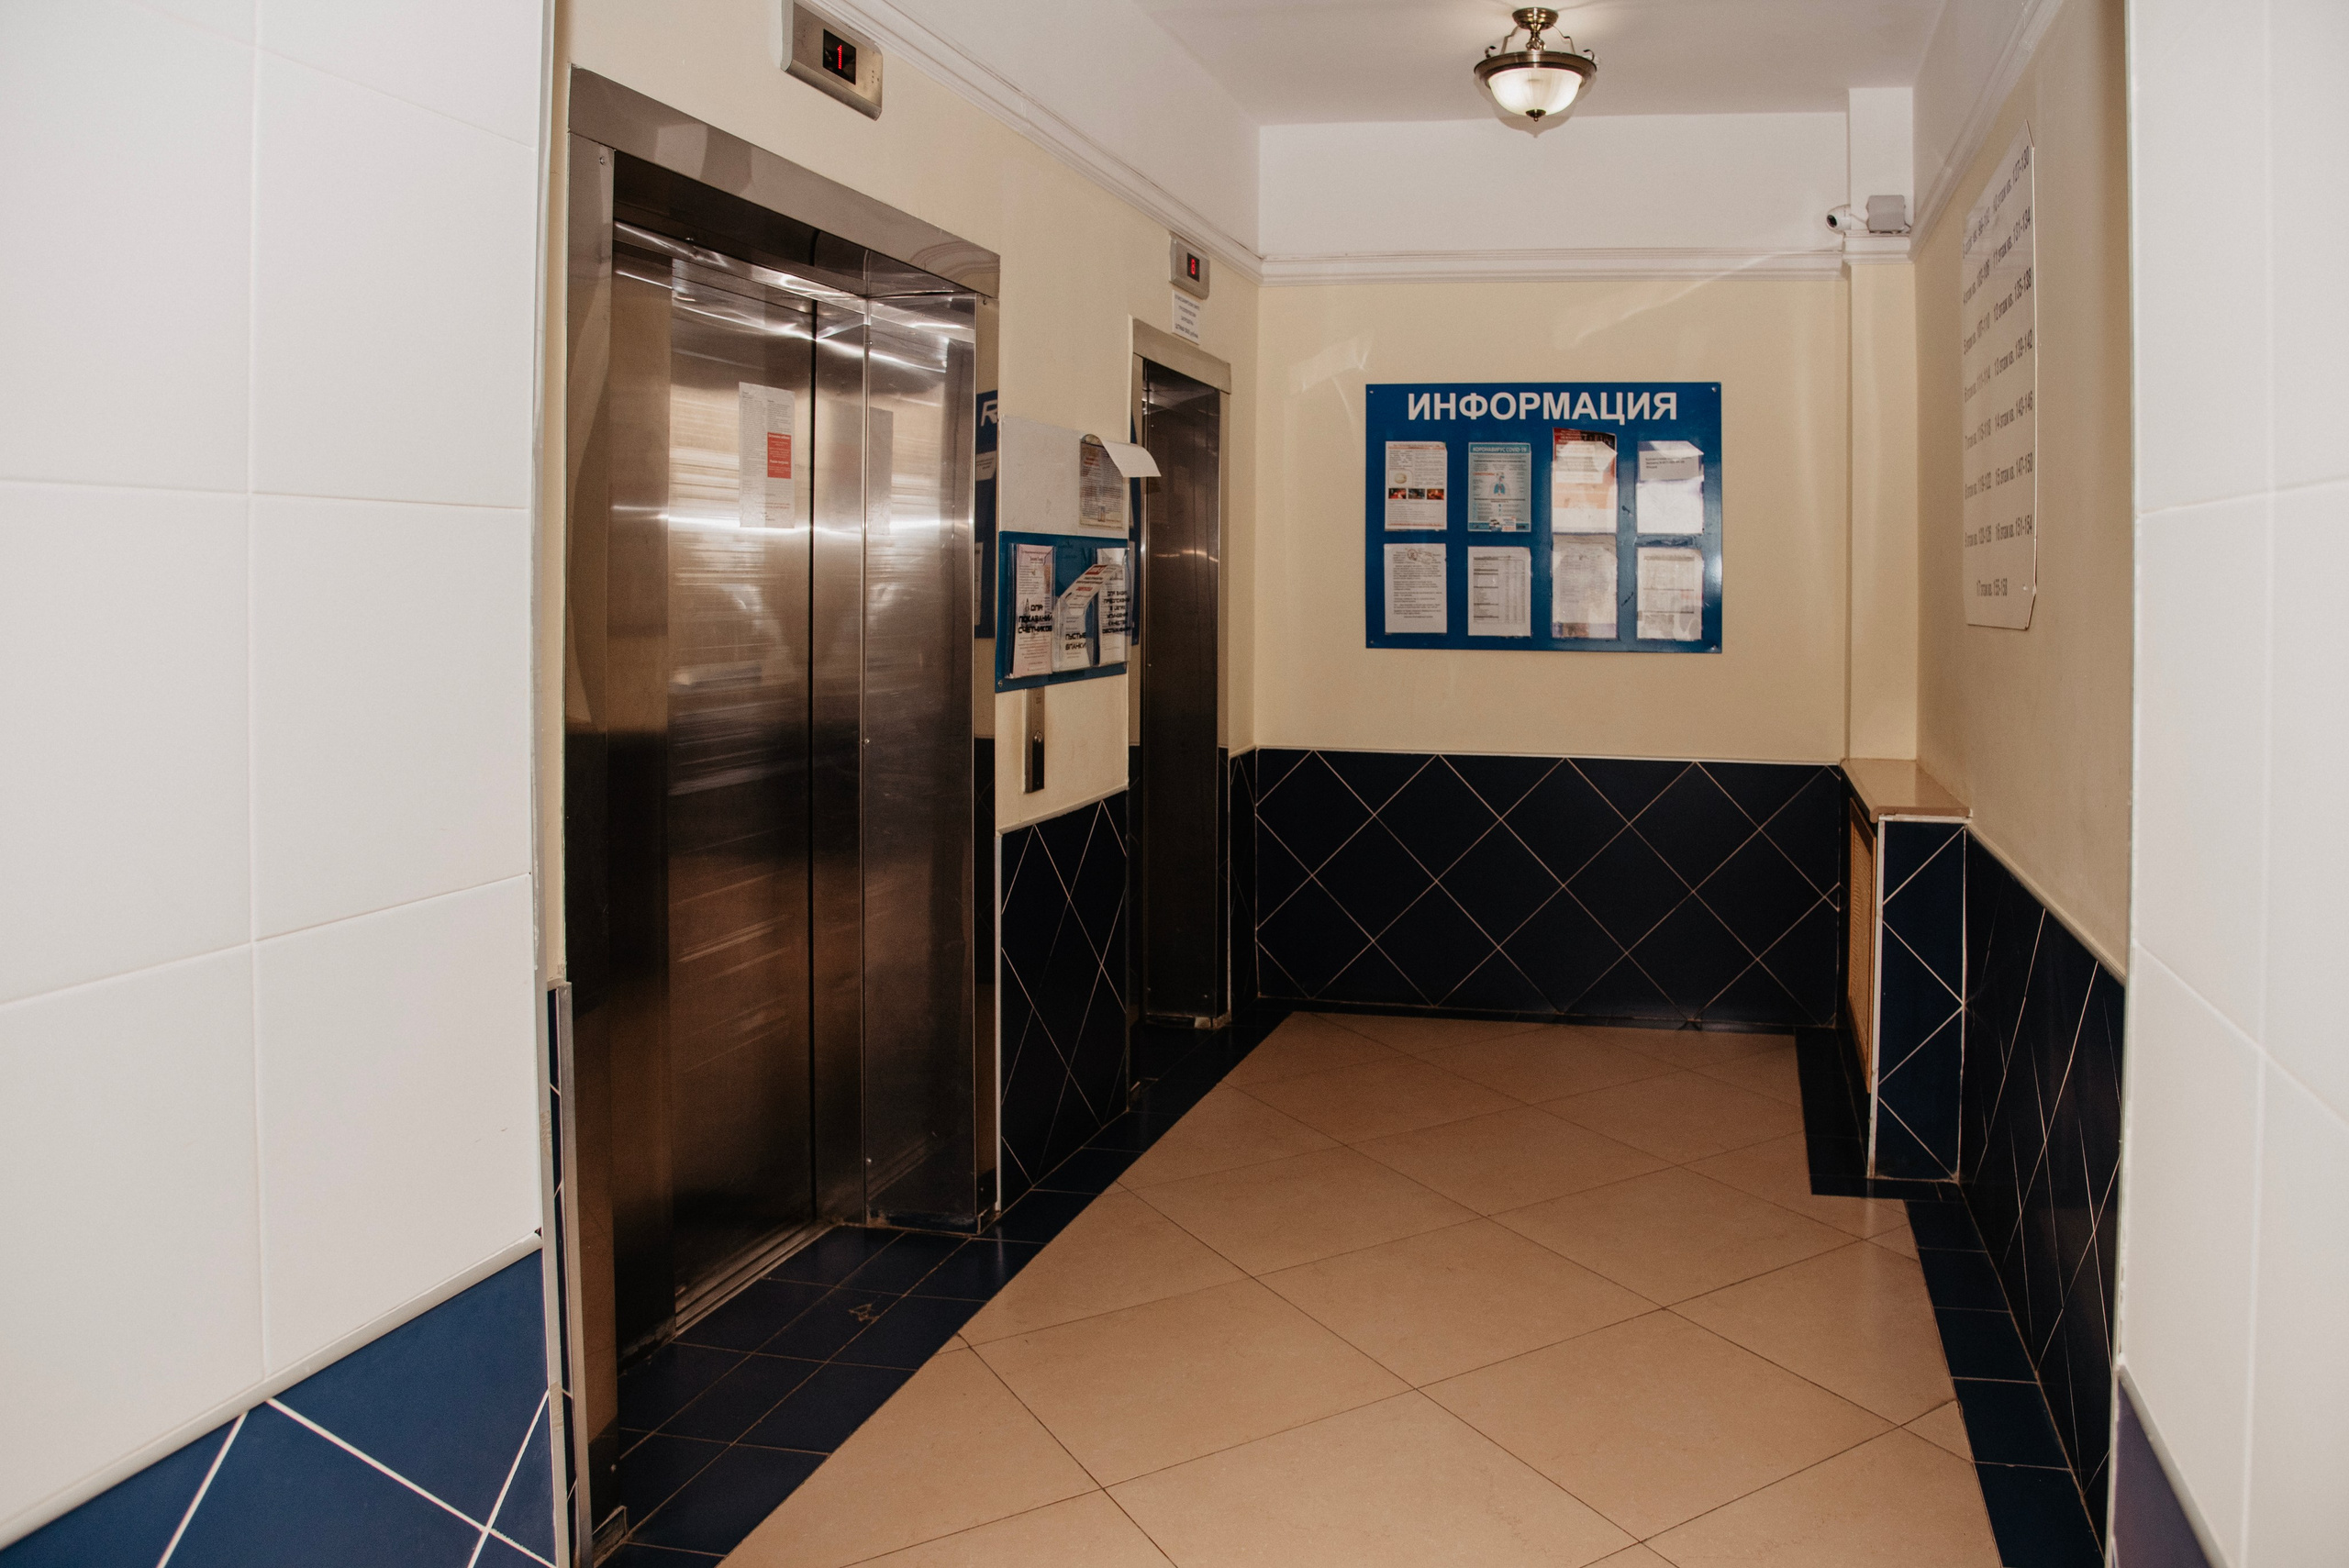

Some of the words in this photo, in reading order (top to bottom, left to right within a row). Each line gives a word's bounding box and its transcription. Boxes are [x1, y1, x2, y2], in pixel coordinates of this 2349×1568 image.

[837, 45, 842, 70] 1
[2012, 145, 2030, 184] 127-130
[2013, 206, 2031, 244] 131-134
[2015, 267, 2032, 302] 135-138
[2016, 328, 2032, 361] 139-142
[1408, 392, 1678, 426] ИНФОРМАЦИЯ
[2016, 390, 2032, 418] 143-146
[2016, 452, 2032, 478] 147-150
[2015, 514, 2032, 537] 151-154
[1993, 578, 2008, 596] 155-158
[1065, 632, 1086, 640] ПУСТЫЕ
